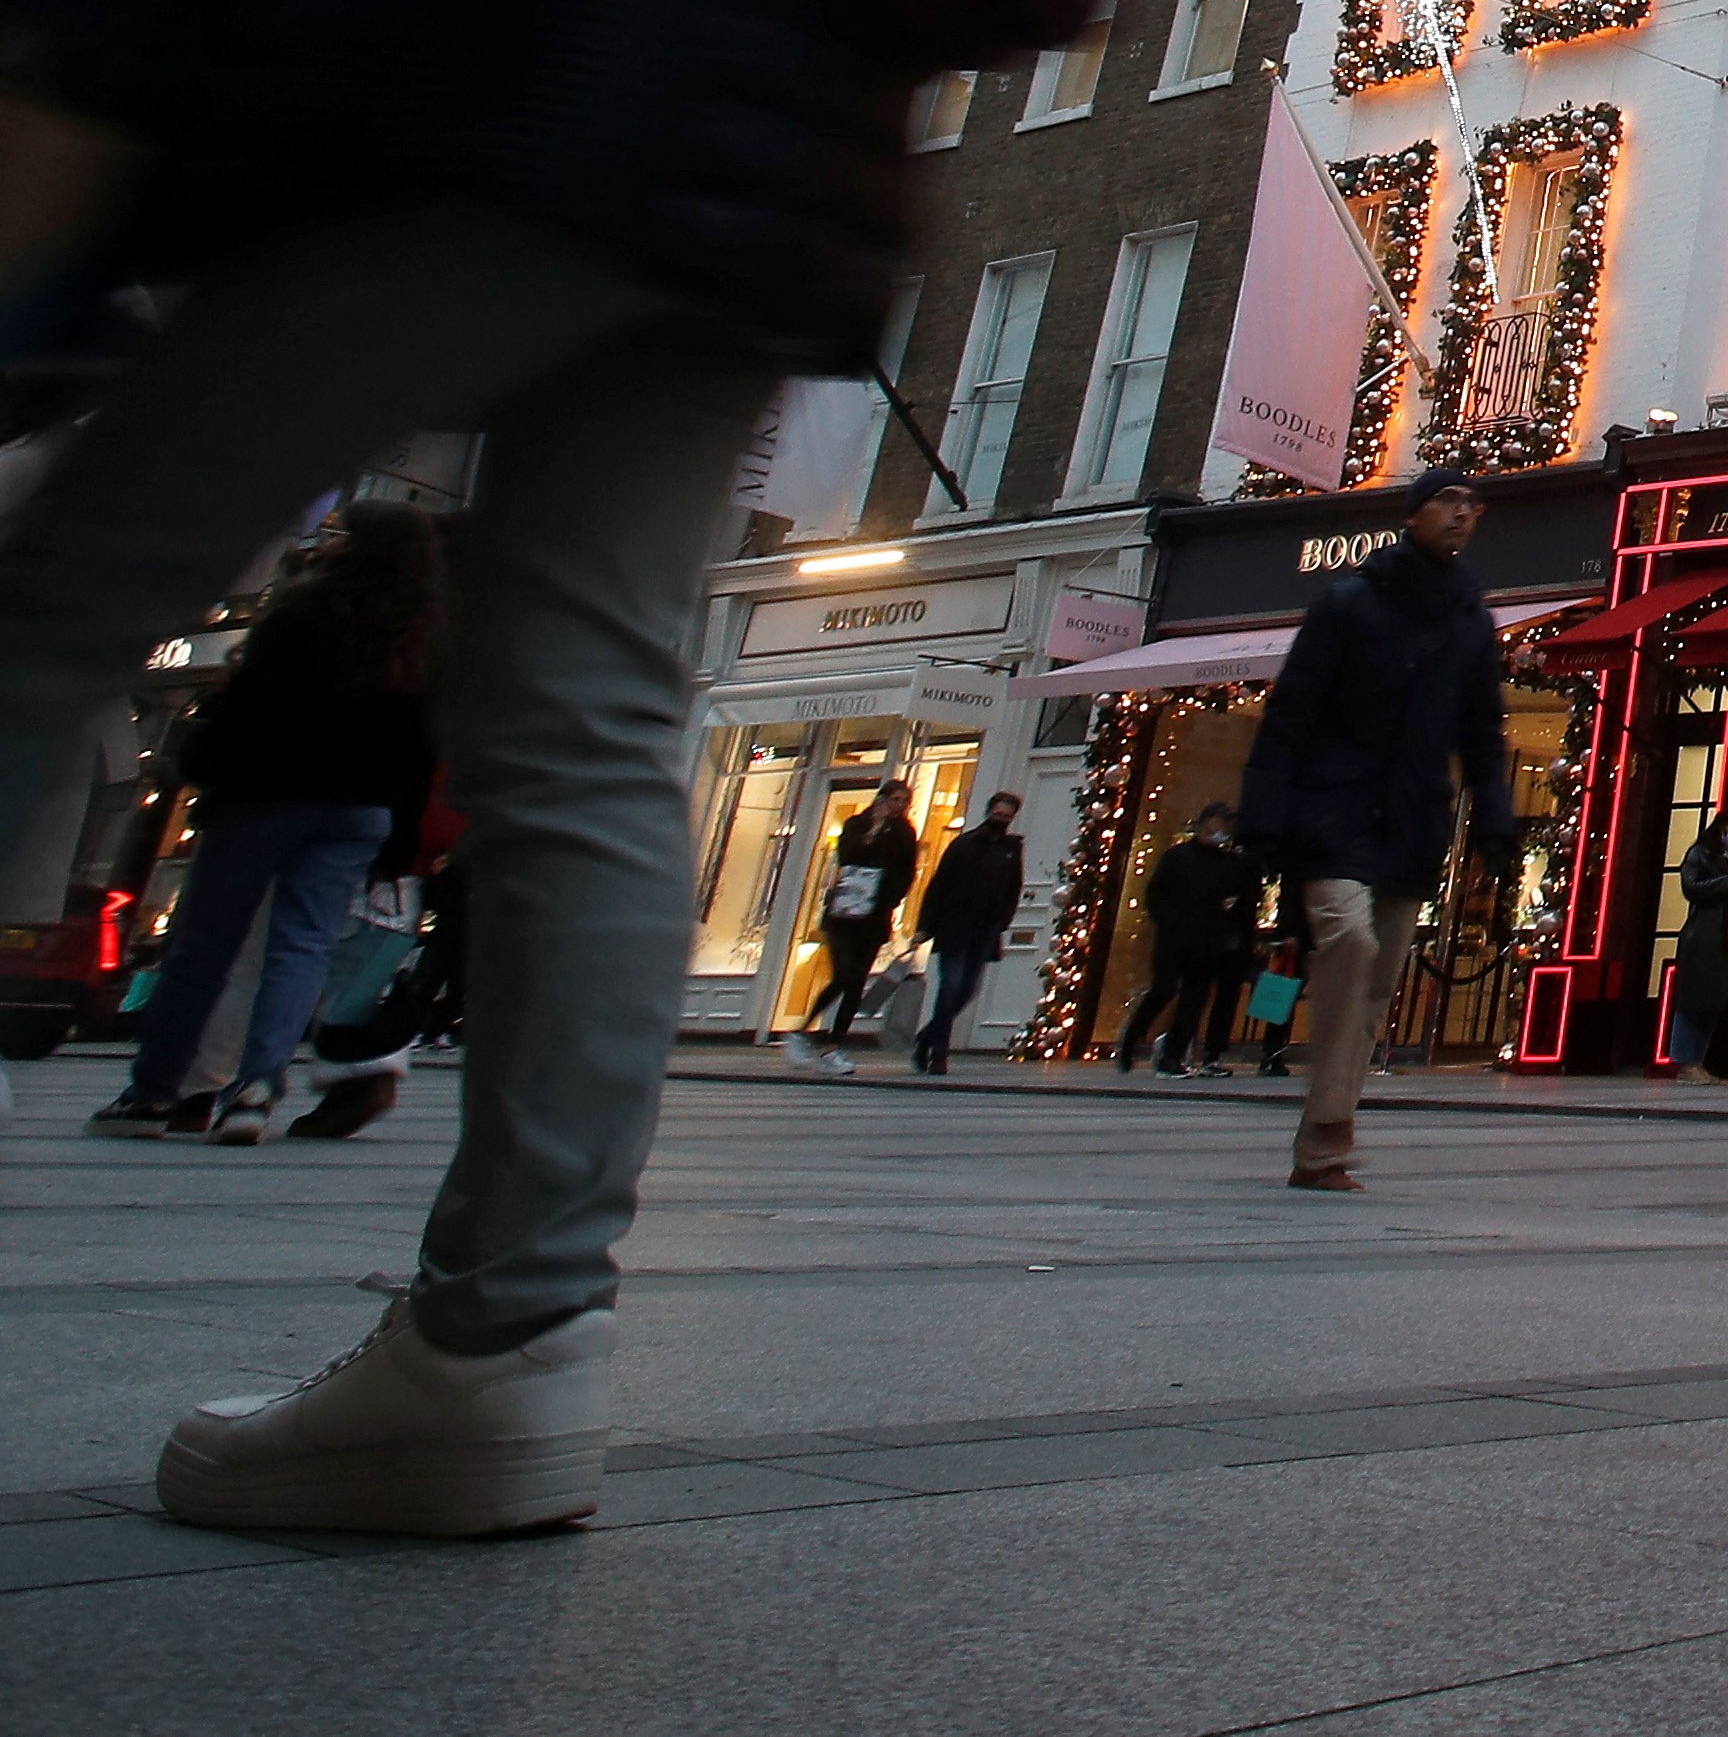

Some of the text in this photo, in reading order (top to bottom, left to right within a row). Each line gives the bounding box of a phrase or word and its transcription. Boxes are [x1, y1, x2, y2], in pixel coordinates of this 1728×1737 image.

[1239, 395, 1337, 449] BOODLES
[1581, 558, 1603, 574] 178
[818, 599, 928, 633] MIKIMOTO
[1065, 616, 1131, 639] BOODLES
[1194, 663, 1252, 679] BOODLES
[790, 695, 879, 720] MIKIMOTO
[921, 687, 994, 708] MIKIMOTO
